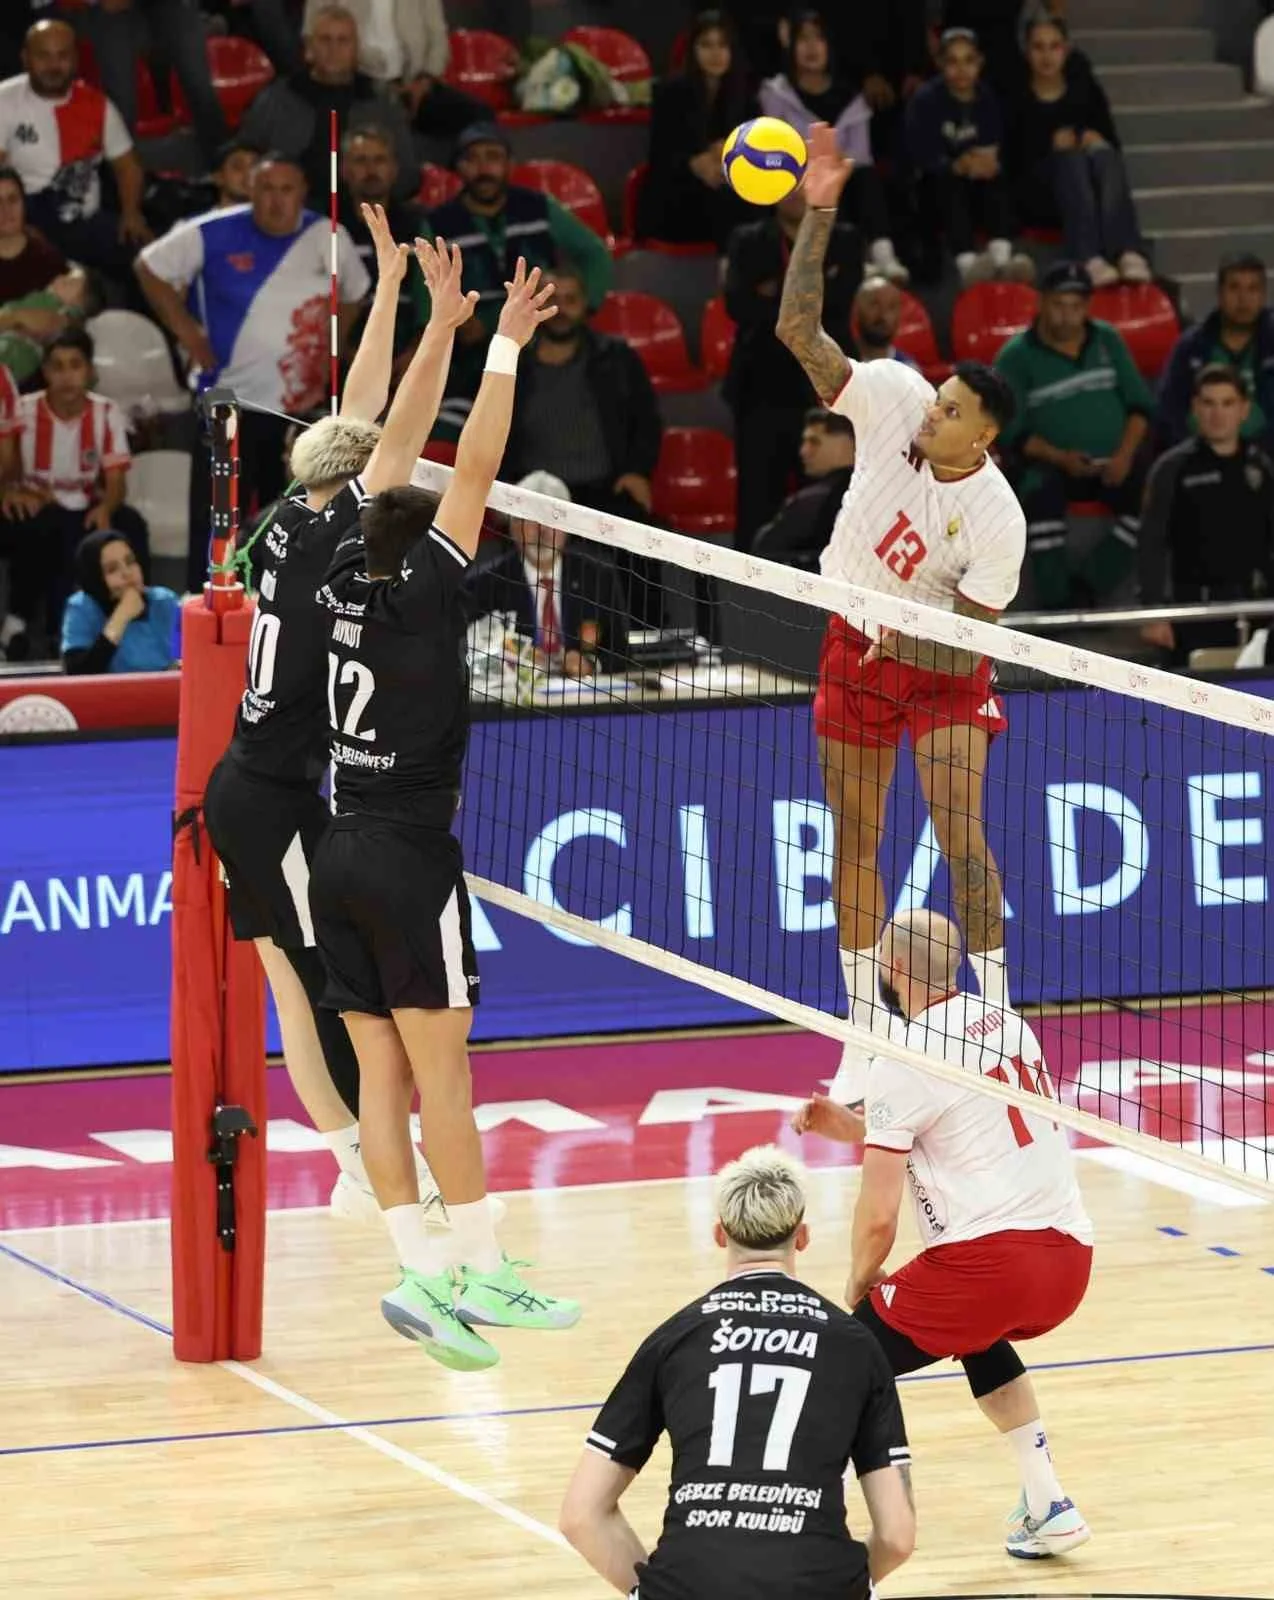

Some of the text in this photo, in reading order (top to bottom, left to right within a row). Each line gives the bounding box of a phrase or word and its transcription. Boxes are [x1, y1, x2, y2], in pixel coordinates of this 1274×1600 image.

[874, 510, 928, 583] 13
[701, 1299, 829, 1321] Solutions
[760, 1289, 822, 1308] Data
[709, 1317, 819, 1359] ŠOTOLA
[707, 1362, 812, 1472] 17
[675, 1482, 727, 1505] GEBZE
[685, 1507, 807, 1535] SPOR KULÜBÜ
